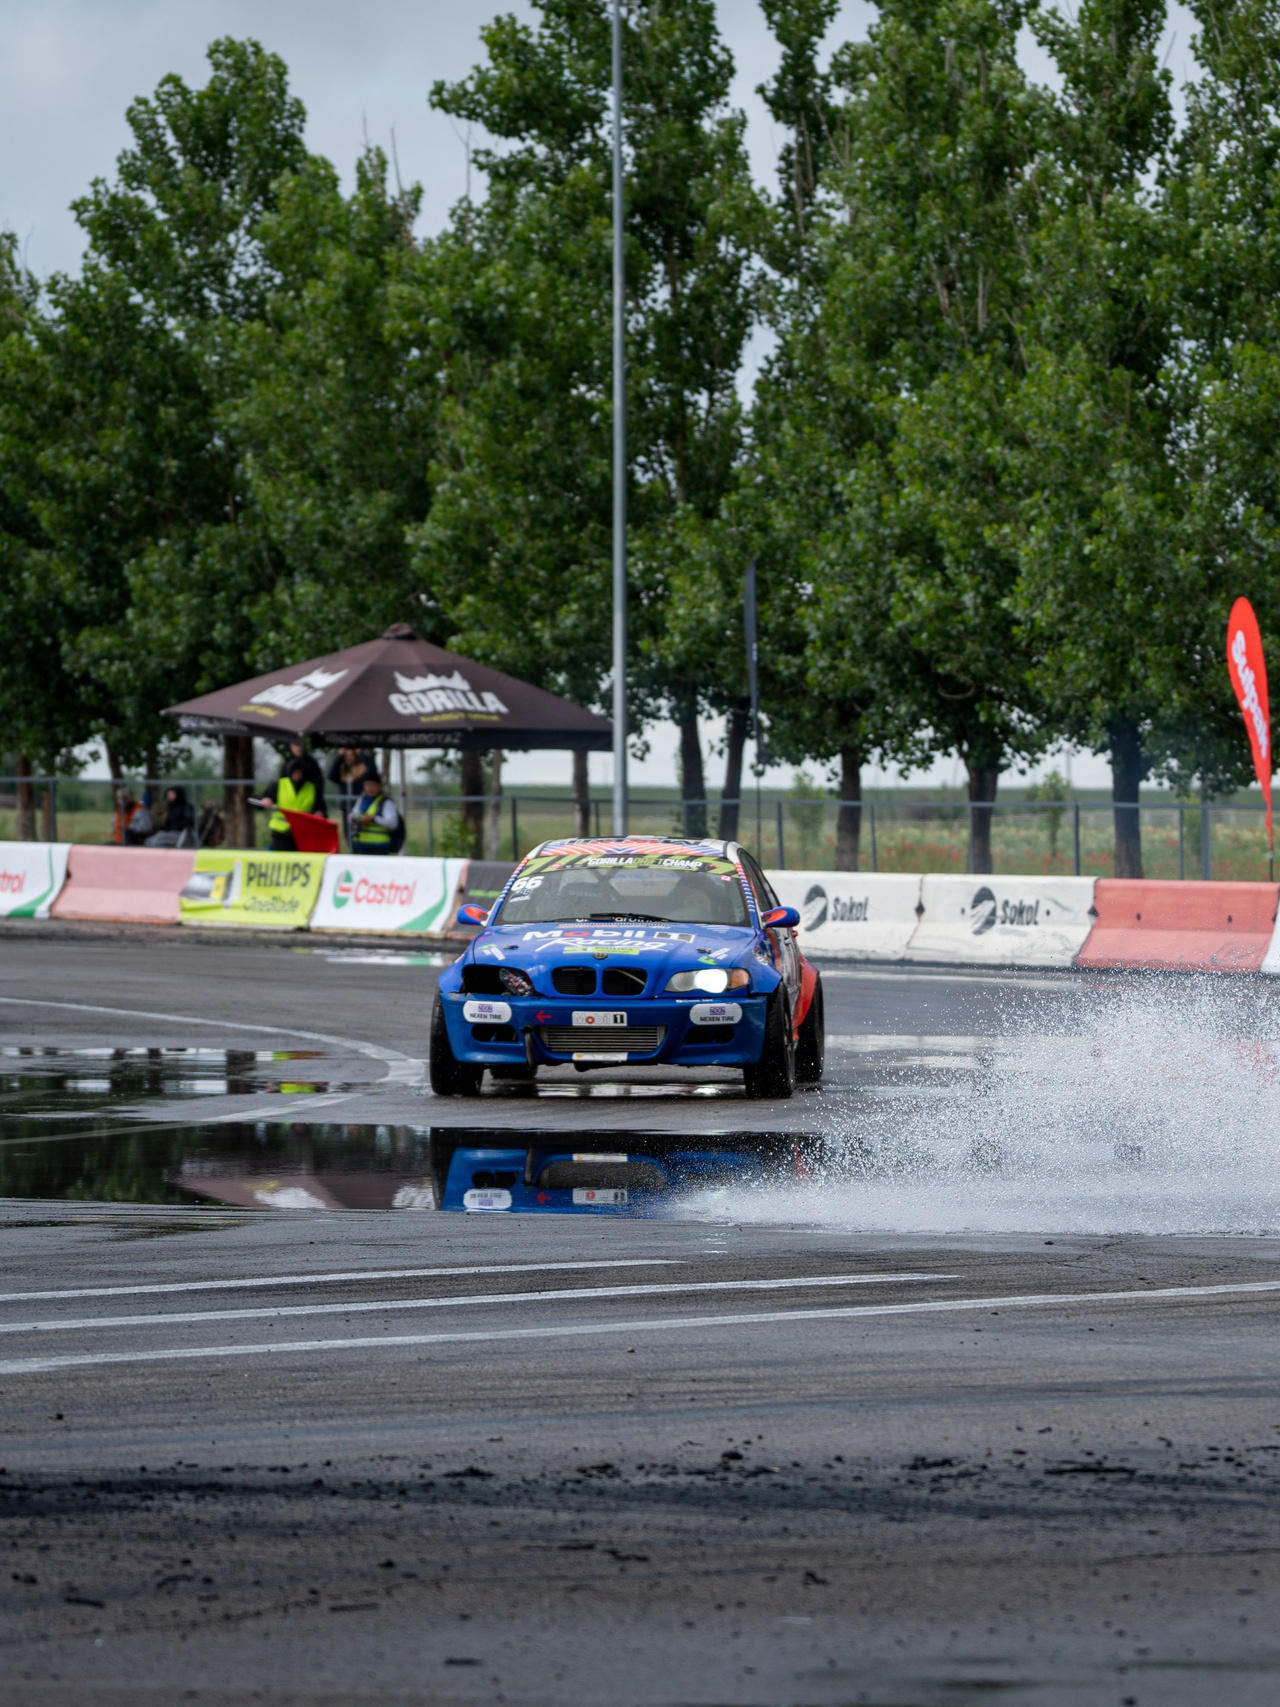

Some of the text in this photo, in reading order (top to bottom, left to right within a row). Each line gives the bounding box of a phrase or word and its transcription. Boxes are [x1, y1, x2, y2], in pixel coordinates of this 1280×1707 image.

[388, 688, 510, 716] GORILLA
[246, 862, 311, 888] PHILIPS
[511, 875, 545, 891] 66
[354, 879, 417, 905] Castrol
[1000, 899, 1040, 926] Sokol
[522, 930, 646, 941] Mobil
[535, 938, 669, 952] Racing
[573, 1012, 611, 1025] Mobil
